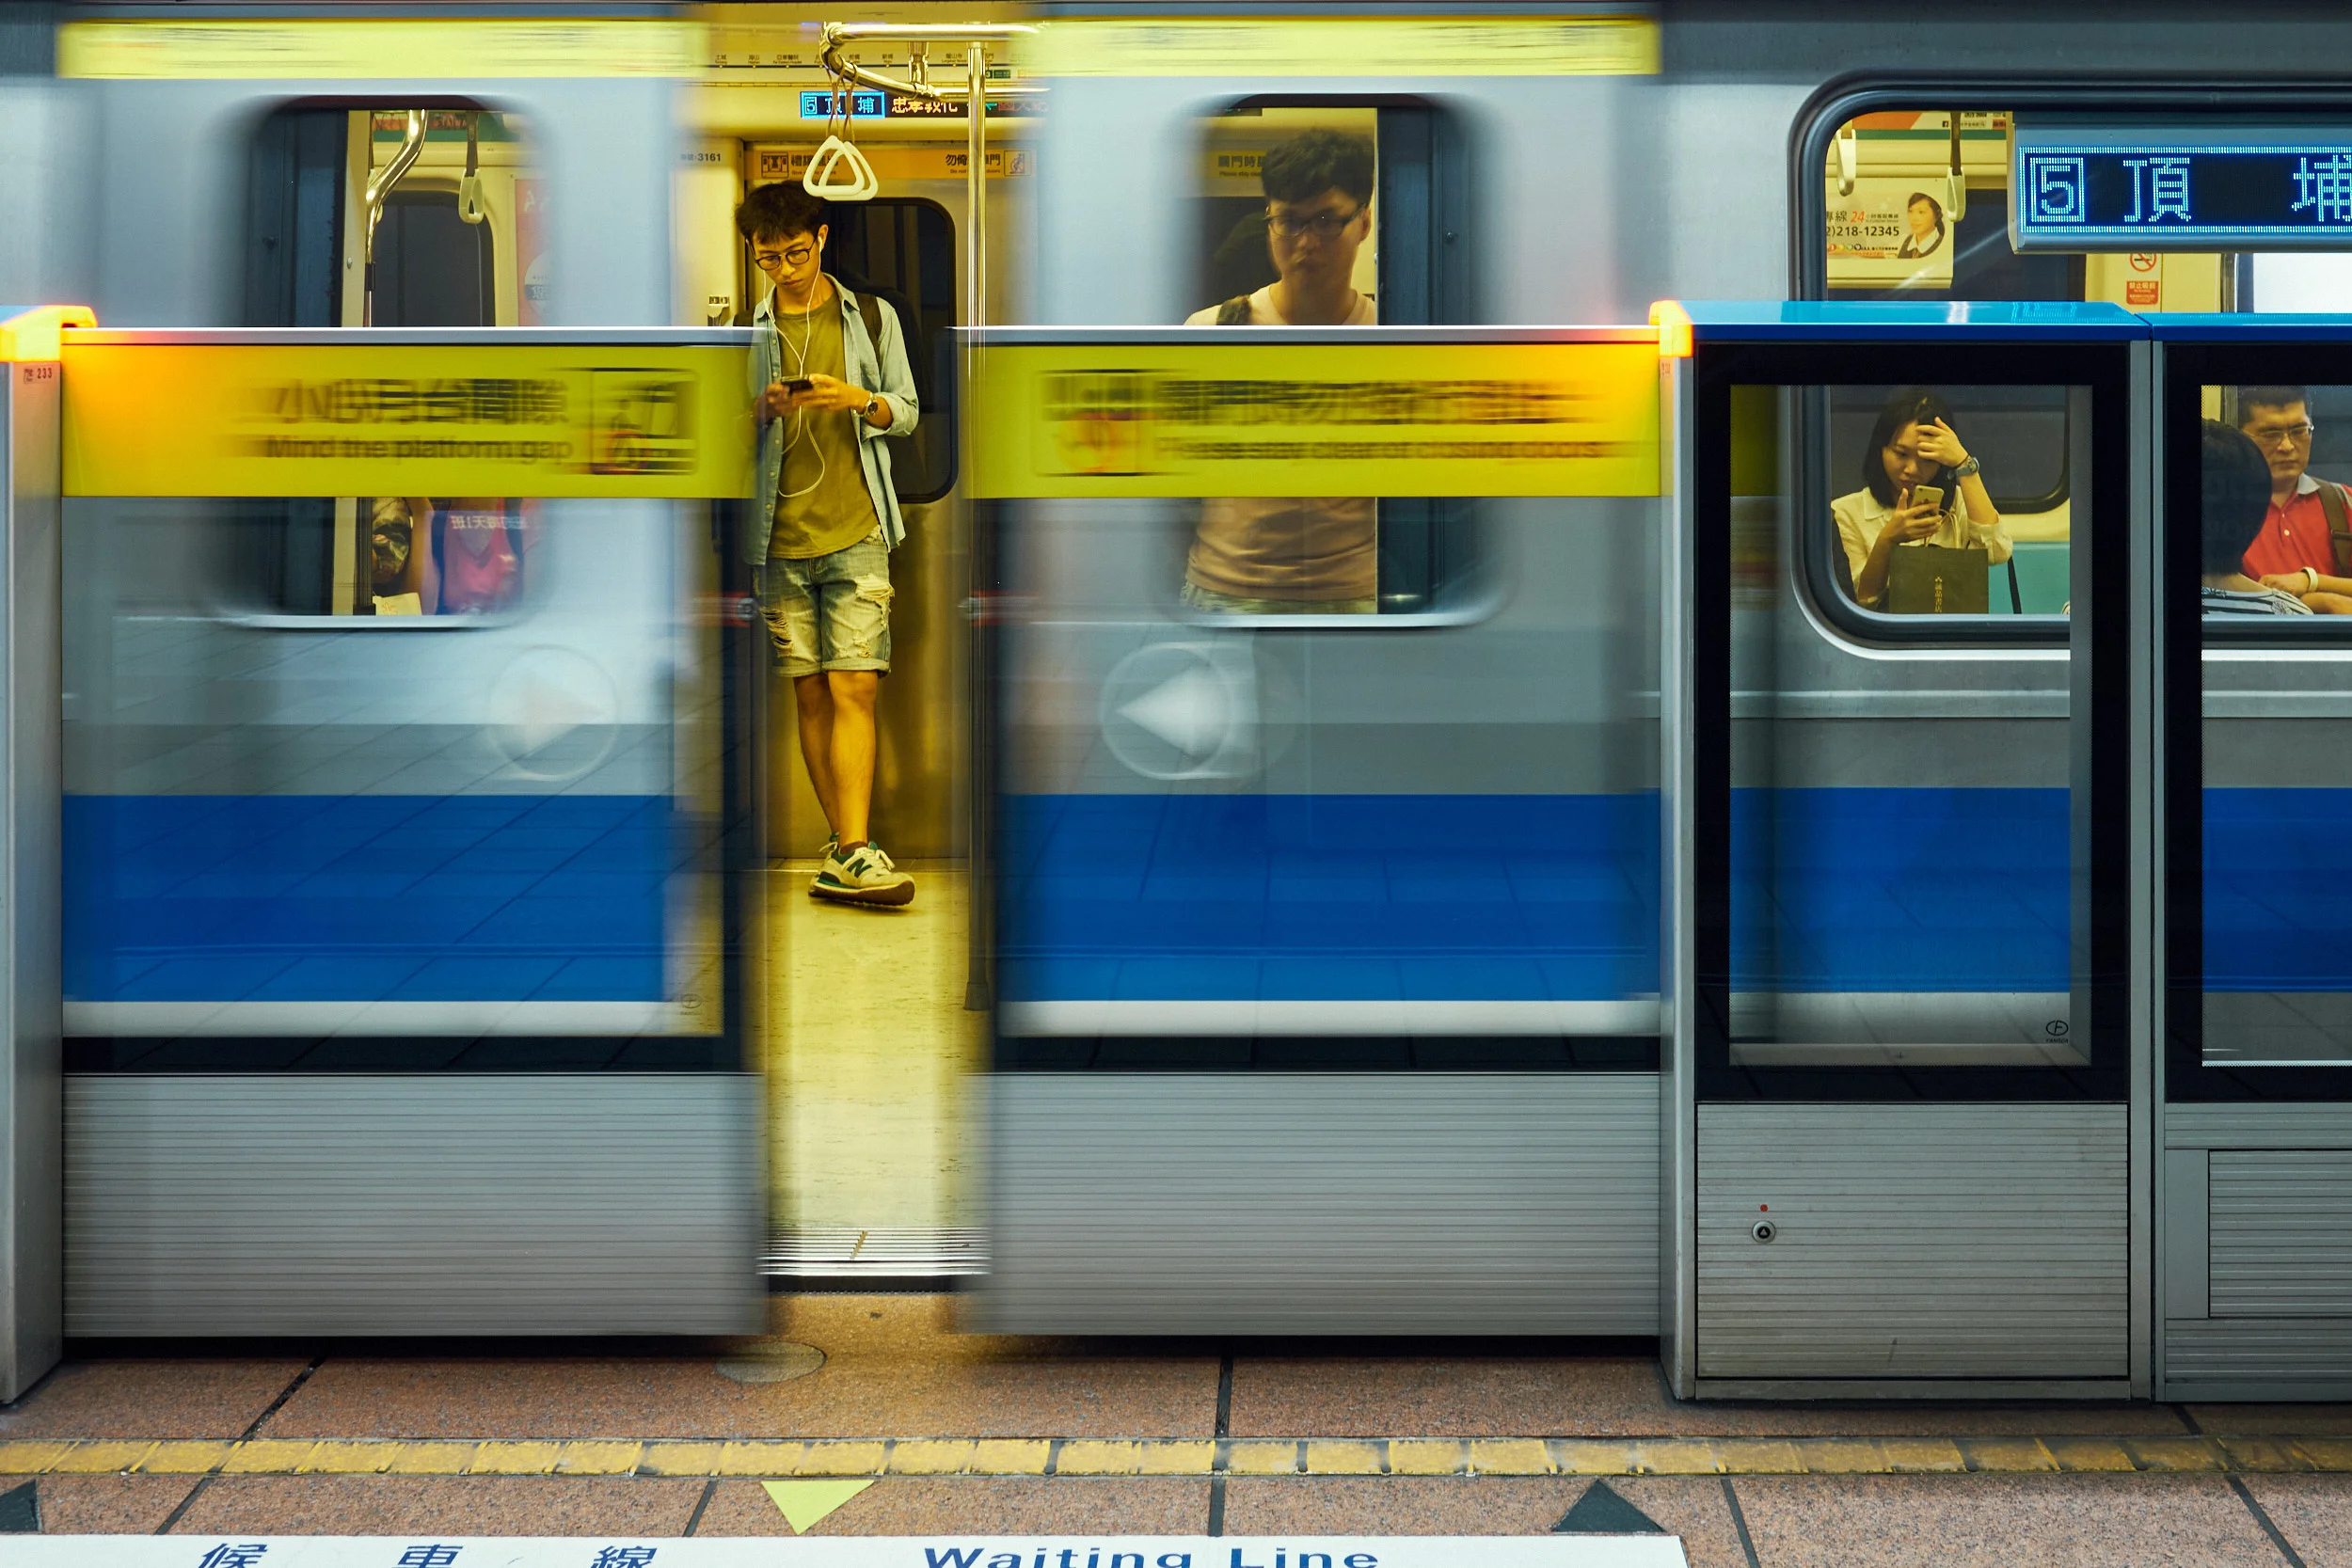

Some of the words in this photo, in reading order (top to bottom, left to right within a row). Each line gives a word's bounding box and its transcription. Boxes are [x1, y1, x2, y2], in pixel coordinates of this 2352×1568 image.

[2040, 164, 2075, 216] 5
[1851, 211, 1866, 223] 24
[37, 367, 53, 379] 233
[1230, 1547, 1379, 1568] Line
